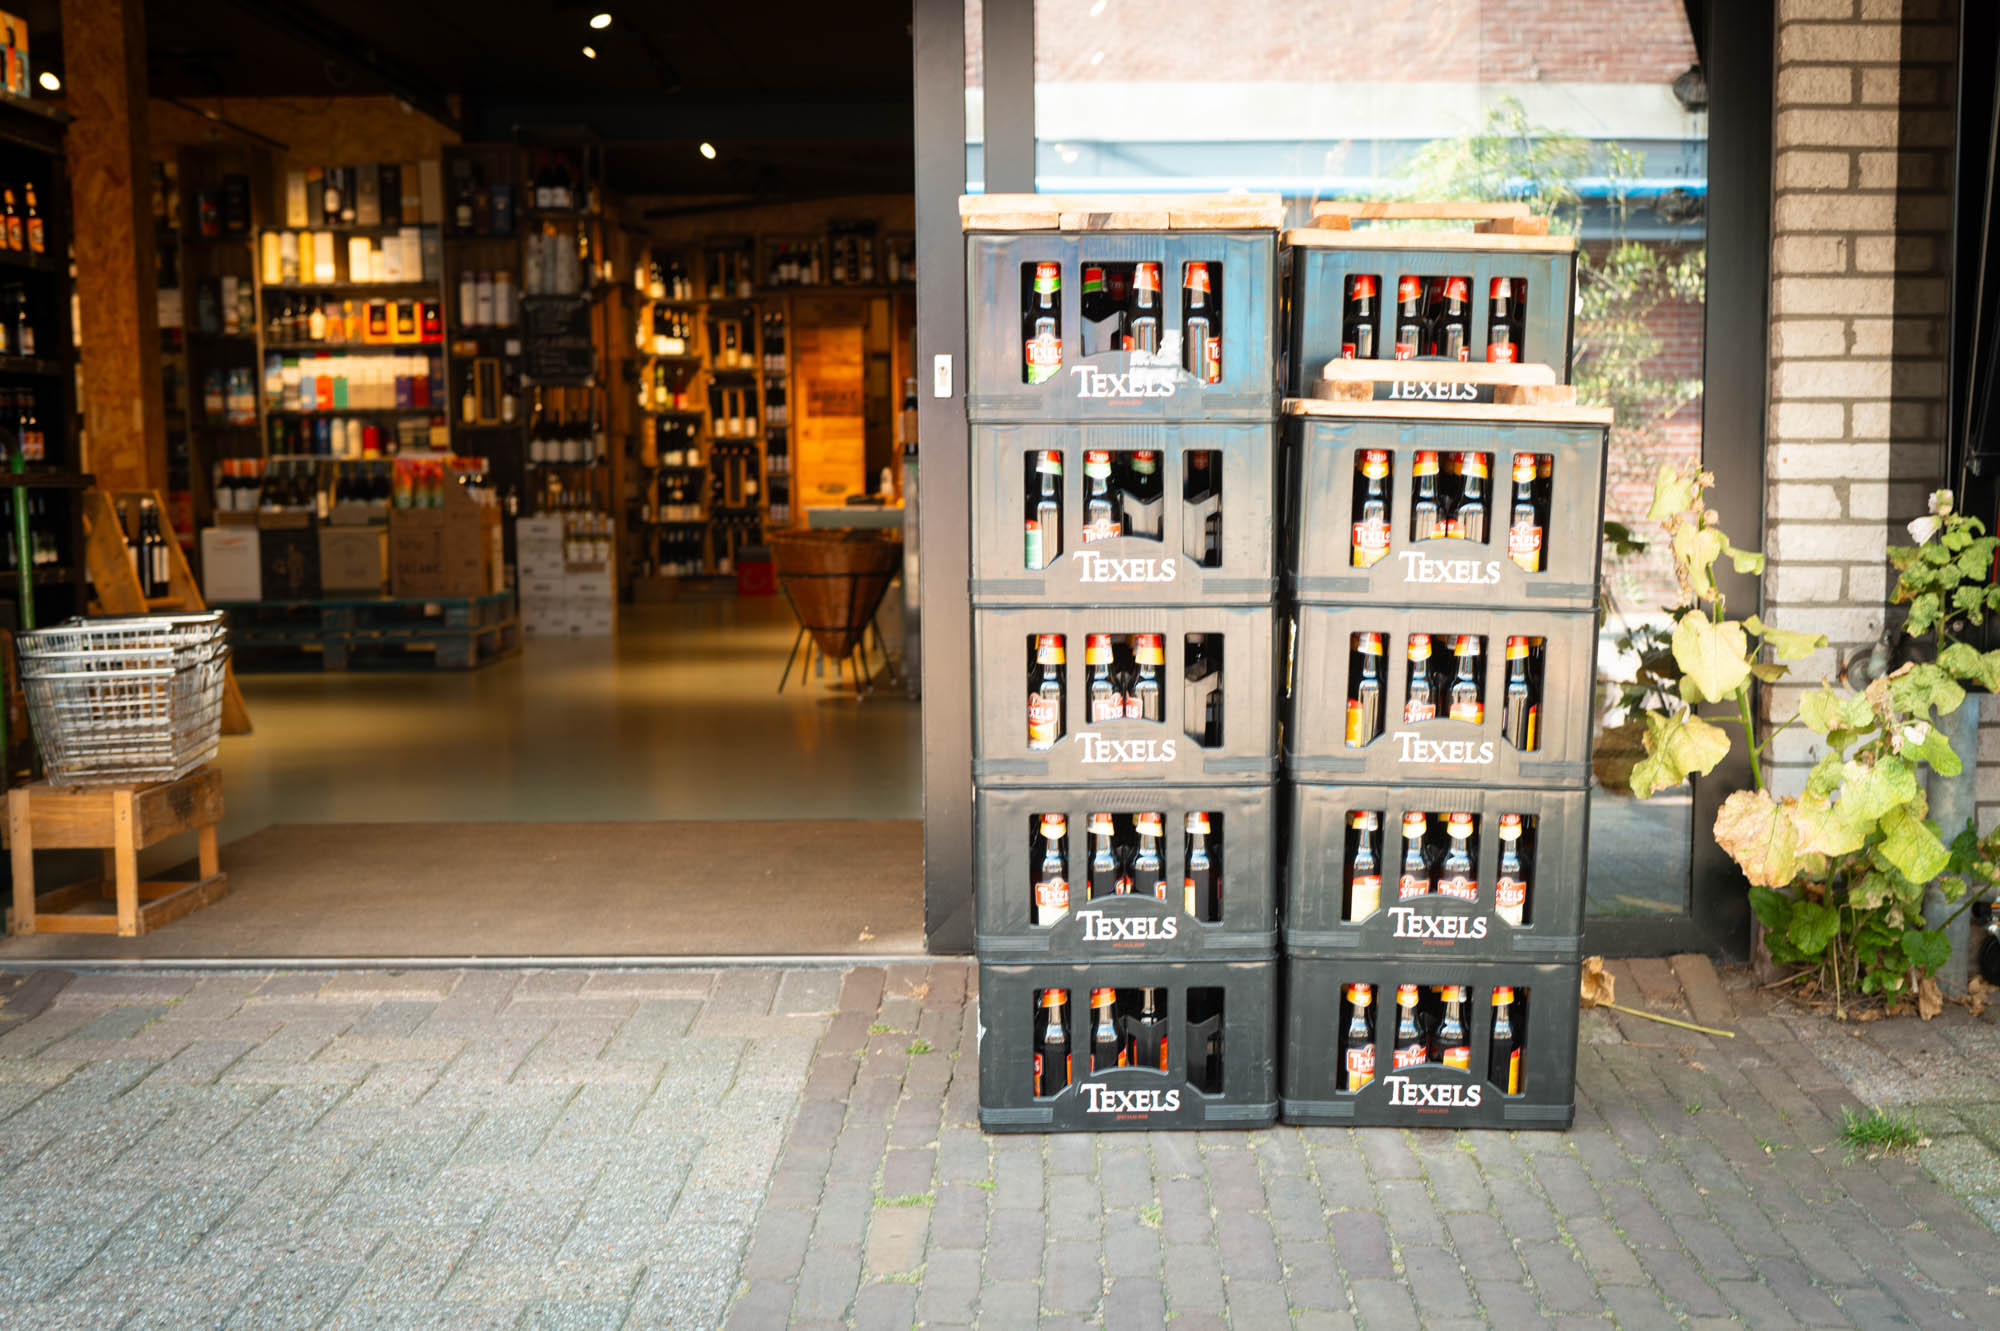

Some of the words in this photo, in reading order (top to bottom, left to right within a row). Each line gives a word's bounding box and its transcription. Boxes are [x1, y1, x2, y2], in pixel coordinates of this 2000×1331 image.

[1071, 365, 1176, 398] TEXELS
[1073, 551, 1176, 582] TEXELS
[1399, 551, 1501, 584] TEXELS
[1029, 706, 1054, 720] XELS
[1075, 732, 1176, 763] TEXELS
[1393, 732, 1494, 764] TEXELS
[1076, 910, 1177, 941] TEXELS
[1388, 907, 1488, 939] TEXELS
[1080, 1083, 1181, 1113] TEXELS
[1383, 1076, 1481, 1107] TEXELS
